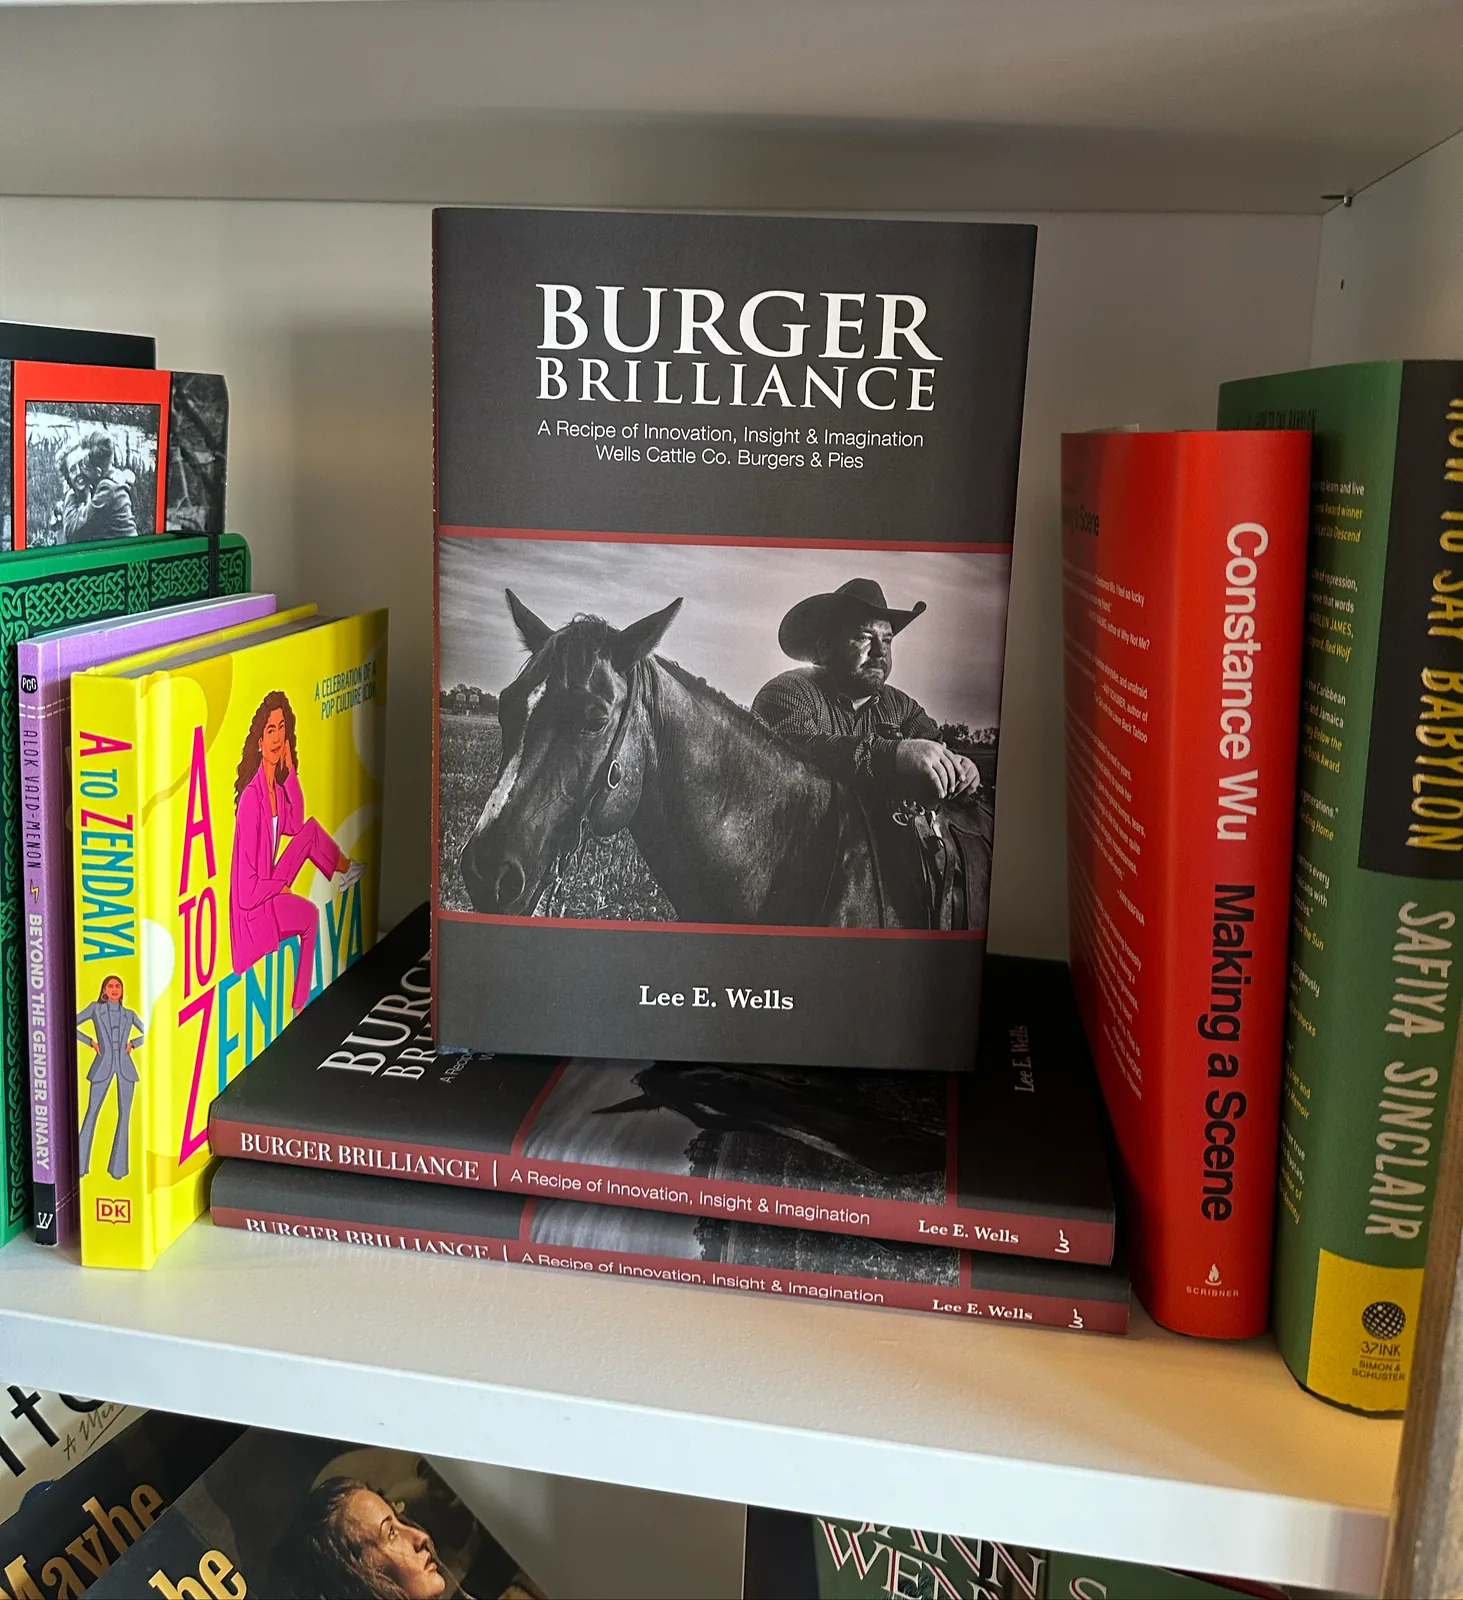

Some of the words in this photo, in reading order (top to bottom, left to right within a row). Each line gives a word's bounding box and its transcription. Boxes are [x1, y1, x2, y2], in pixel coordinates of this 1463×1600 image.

[535, 283, 943, 361] BURGER
[536, 356, 935, 412] BRILLIANCE
[537, 420, 552, 436] A
[556, 420, 616, 441] Recipe
[621, 422, 639, 439] of
[644, 424, 738, 445] Innovation,
[744, 426, 800, 449] Insight
[806, 430, 819, 444] &
[824, 430, 924, 450] Imagination
[595, 445, 641, 463] Wells
[646, 446, 697, 464] Cattle
[701, 449, 731, 466] Co.
[738, 451, 805, 470] Burgers
[810, 453, 823, 467] &
[828, 452, 865, 469] Pies
[1340, 482, 1351, 495] and
[1351, 482, 1365, 496] live
[1341, 506, 1364, 520] winner
[1334, 599, 1355, 614] words
[1218, 521, 1269, 760] Constance
[1330, 617, 1354, 639] JAMES,
[1336, 644, 1352, 663] Wolf
[322, 665, 363, 698] CELEBRATION
[1317, 682, 1346, 706] Caribbean
[321, 697, 336, 720] POP
[336, 686, 362, 714] CULTURE
[1319, 707, 1344, 728] Jamaica
[24, 730, 39, 768] ALOK
[79, 730, 133, 757] A
[1330, 736, 1342, 752] the
[1321, 753, 1340, 774] Award
[79, 767, 119, 799] TO
[179, 725, 217, 897] A
[1216, 768, 1259, 841] Wu
[25, 776, 42, 869] VAID-MENON
[1315, 820, 1335, 841] Home
[80, 808, 136, 962] ZENDAYA
[1312, 867, 1330, 889] every
[28, 913, 44, 989] BEYOND
[178, 886, 218, 1001] TO
[1312, 932, 1325, 951] Sun
[1197, 883, 1256, 1042] Making
[1383, 901, 1456, 1038] SAFIYA
[31, 992, 45, 1026] THE
[316, 948, 432, 1078] BURG
[639, 985, 685, 1008] Lee
[692, 986, 717, 1008] E.
[725, 987, 795, 1011] Wells
[1009, 1024, 1030, 1053] Wells
[33, 1030, 48, 1102] GENDER
[1012, 1055, 1032, 1069] E.
[1207, 1052, 1239, 1078] a
[1014, 1069, 1035, 1093] Lee
[35, 1105, 50, 1170] BINARY
[1364, 1060, 1440, 1241] SINCLAIR
[1200, 1089, 1247, 1222] Scene
[240, 1131, 334, 1163] BURGER
[338, 1143, 480, 1182] BRILLIANCE
[510, 1169, 523, 1184] A
[527, 1171, 582, 1193] Recipe
[586, 1176, 603, 1193] of
[606, 1178, 693, 1206] Innovation,
[699, 1190, 753, 1212] Insight
[758, 1199, 770, 1213] &
[774, 1199, 871, 1226] Imagination
[918, 1219, 949, 1237] Lee
[953, 1223, 969, 1239] E.
[973, 1225, 1020, 1244] Wells
[101, 1204, 127, 1218] DK
[245, 1218, 340, 1242] BURGER
[344, 1230, 491, 1260] BRILLIANCE
[521, 1252, 536, 1264] A
[538, 1253, 593, 1271] Recipe
[598, 1259, 615, 1273] of
[618, 1262, 706, 1285] Innovation,
[711, 1273, 766, 1292] Insight
[771, 1281, 783, 1293] &
[788, 1282, 885, 1303] Imagination
[932, 1299, 962, 1314] Lee
[966, 1302, 983, 1316] E.
[987, 1304, 1033, 1321] Wells
[1185, 1285, 1239, 1298] SCRIBNER
[1352, 1367, 1406, 1381] SCHUSTER
[1359, 1360, 1393, 1372] SIMON
